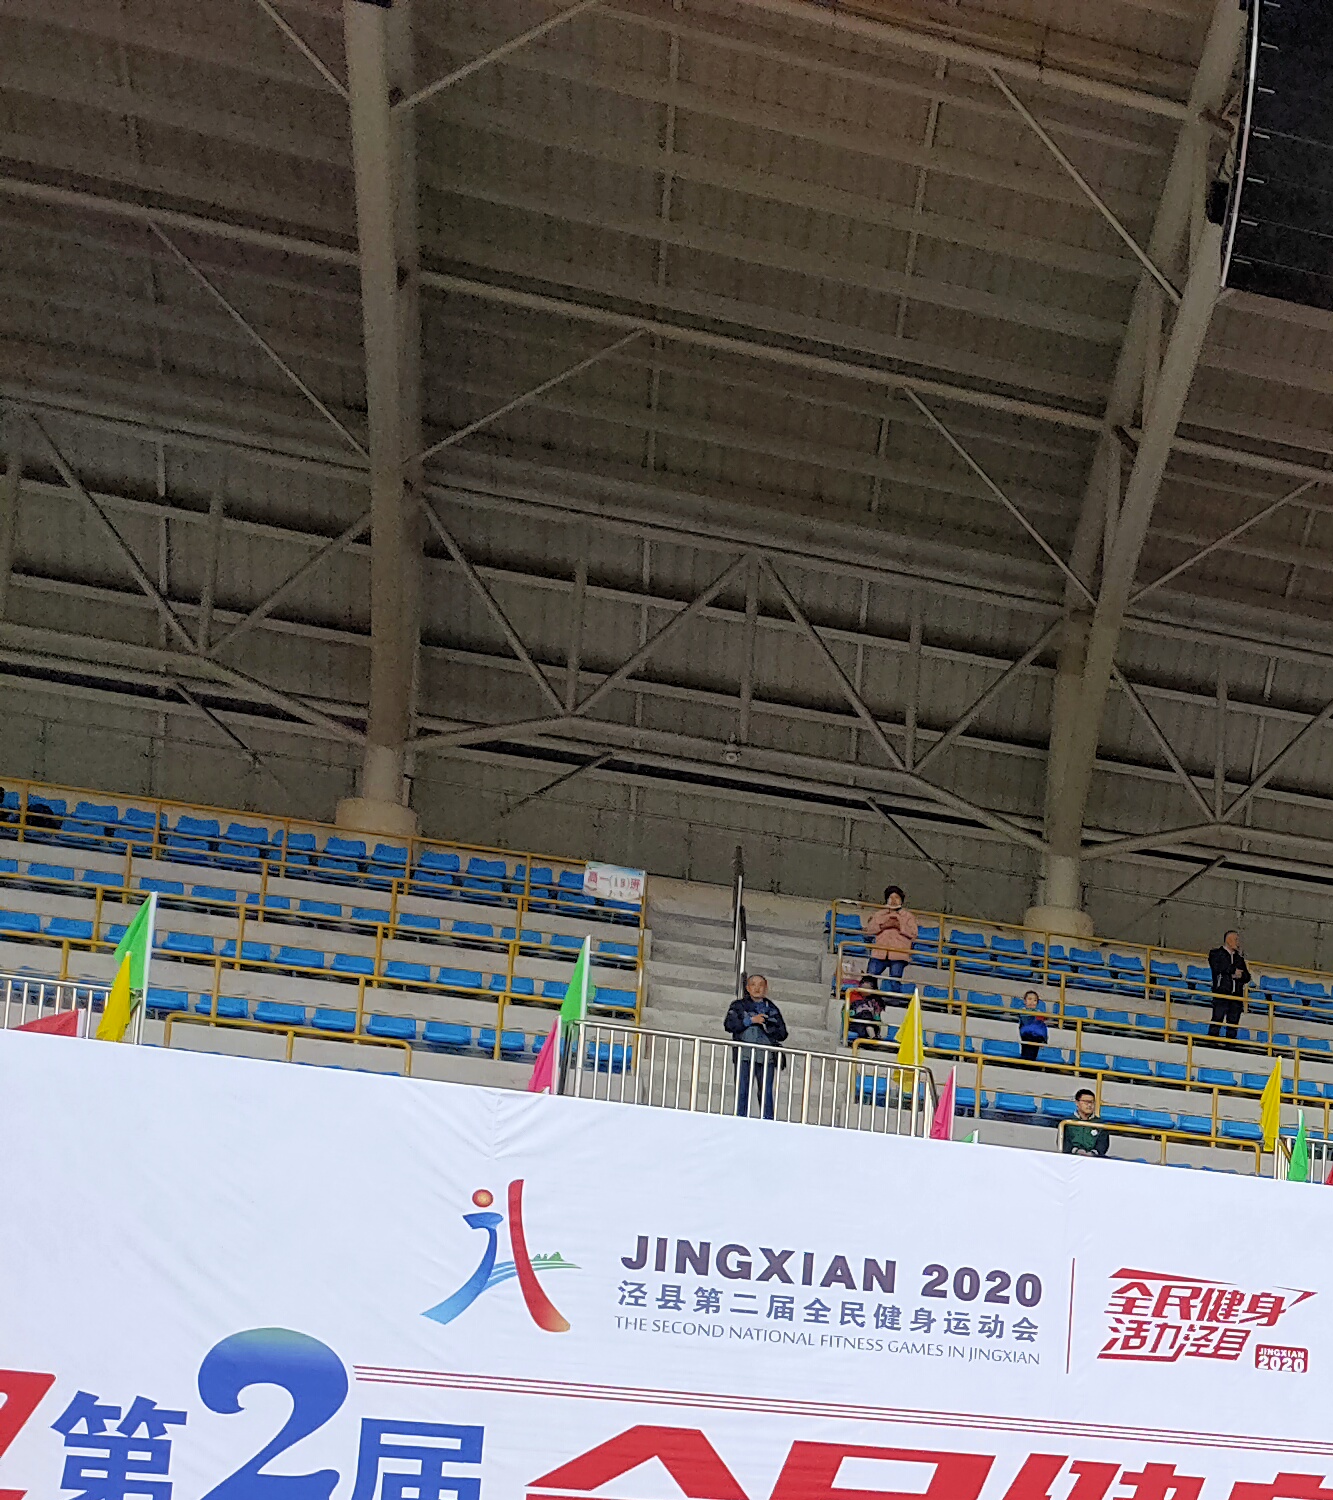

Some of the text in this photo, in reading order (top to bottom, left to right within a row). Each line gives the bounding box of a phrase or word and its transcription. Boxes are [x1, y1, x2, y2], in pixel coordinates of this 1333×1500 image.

[621, 1235, 1043, 1308] JINGXIAN 2020
[617, 1280, 1039, 1343] 泾县第二届全民健身运动会
[1103, 1281, 1287, 1327] 全民健身
[615, 1315, 1041, 1365] THE SECOND NATIONAL FITNESS GAMES IN JINGXIAN
[1096, 1316, 1252, 1363] 活力泾县
[1258, 1347, 1305, 1359] JINGXIAN
[1257, 1356, 1305, 1373] 2020
